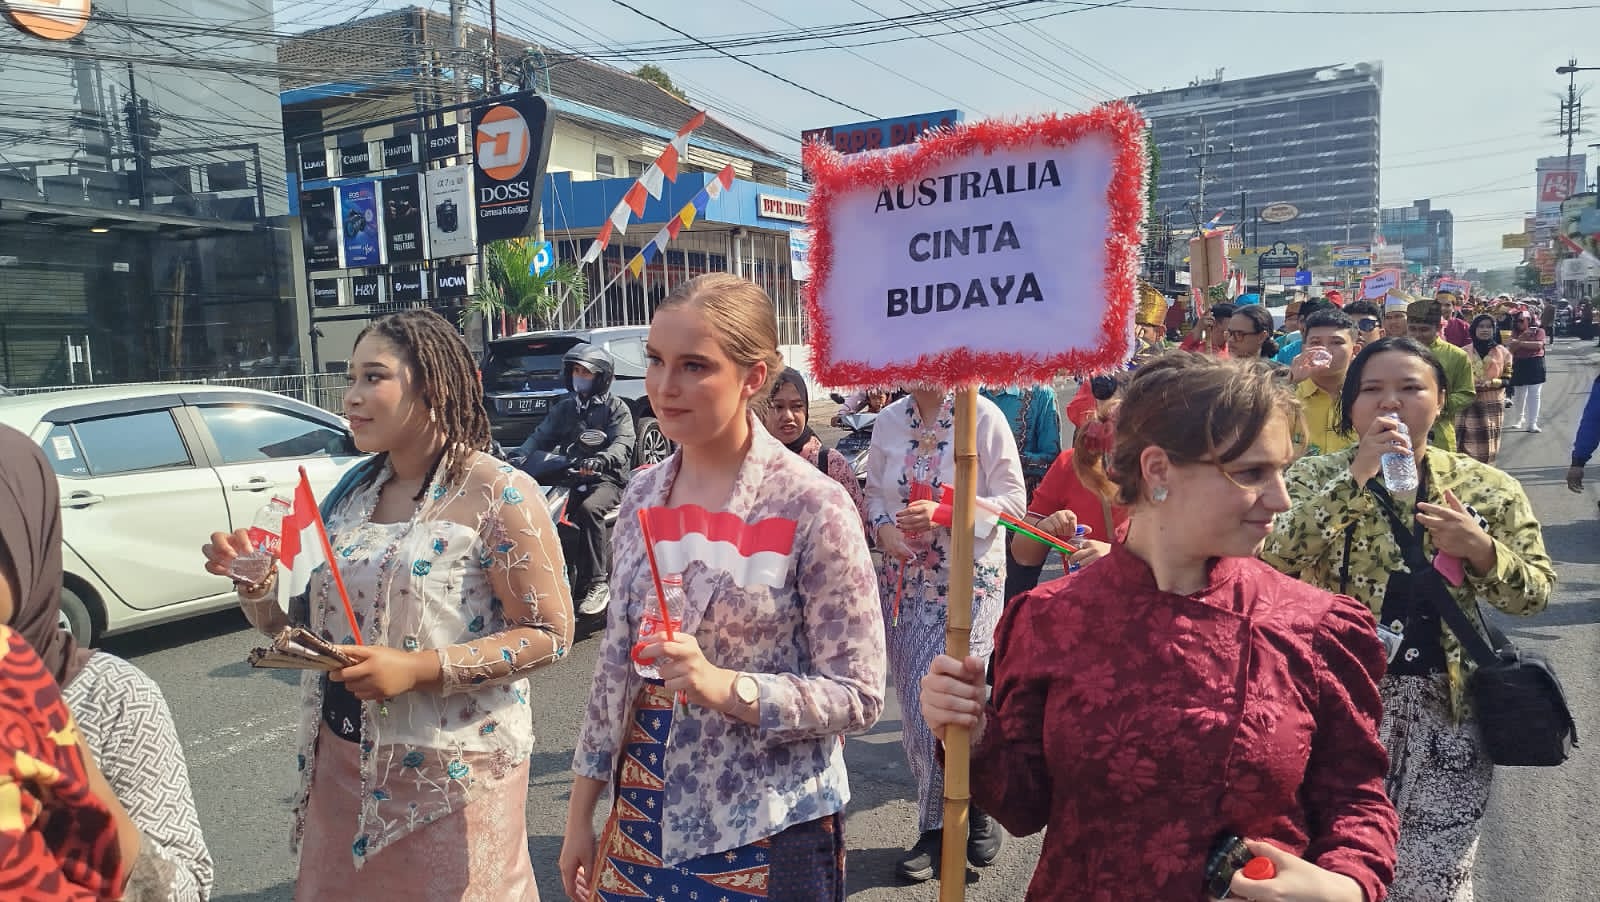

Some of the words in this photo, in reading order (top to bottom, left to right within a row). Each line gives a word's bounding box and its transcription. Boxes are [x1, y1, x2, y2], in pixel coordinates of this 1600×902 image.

[430, 135, 457, 148] SONY
[835, 127, 883, 153] BPR
[343, 153, 369, 165] Canon
[480, 181, 530, 203] DOSS
[874, 158, 1062, 214] AUSTRALIA
[763, 198, 783, 214] BPR
[908, 220, 1021, 263] CINTA
[533, 248, 549, 278] P
[355, 284, 377, 297] H&Y
[886, 271, 1044, 318] BUDAYA
